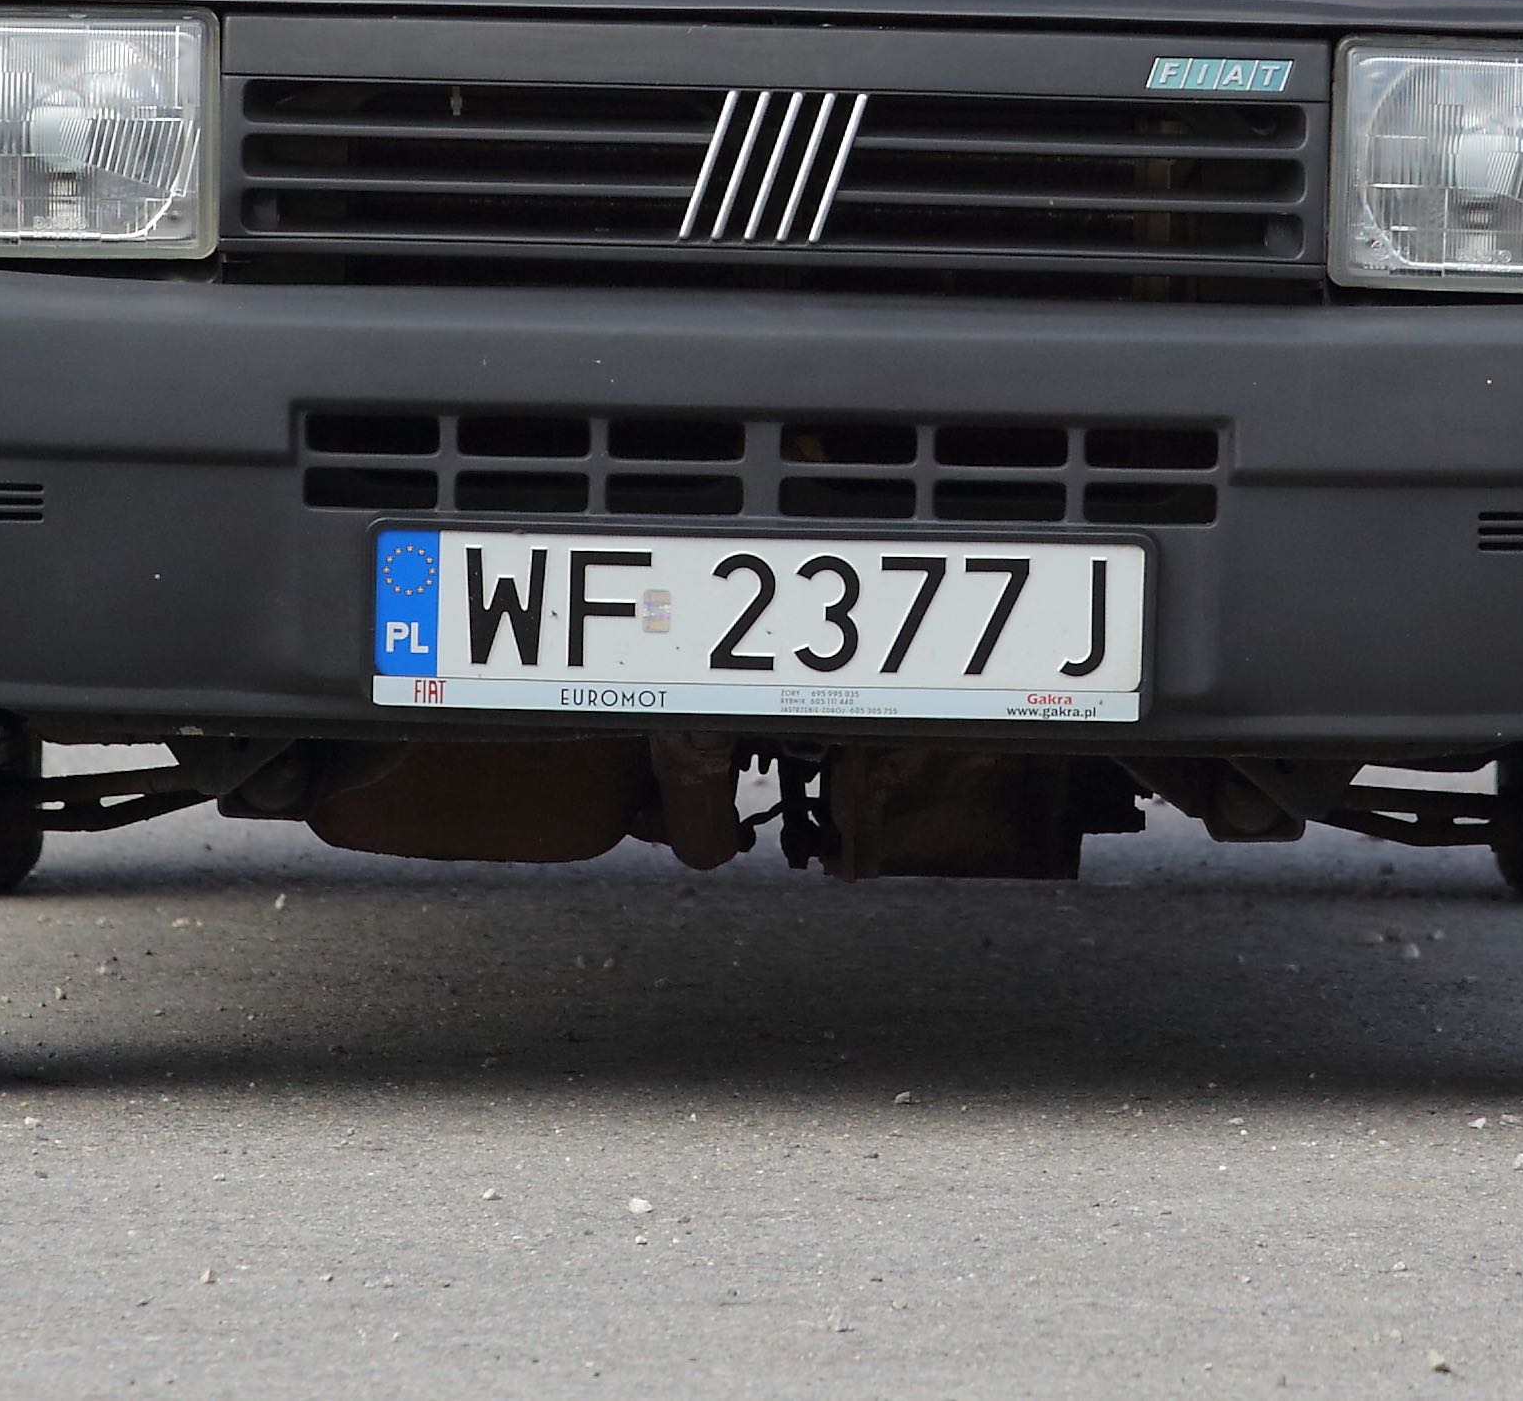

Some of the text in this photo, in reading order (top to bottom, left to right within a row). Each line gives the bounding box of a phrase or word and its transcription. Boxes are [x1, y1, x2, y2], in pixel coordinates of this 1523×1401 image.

[1158, 62, 1281, 87] FIAT
[465, 546, 1107, 677] WF 2377J
[385, 621, 430, 654] PL
[414, 680, 447, 704] FIAT
[560, 688, 668, 708] EUROMOT
[1027, 693, 1073, 705] Gakra
[1006, 706, 1096, 719] www.gakra.pl
